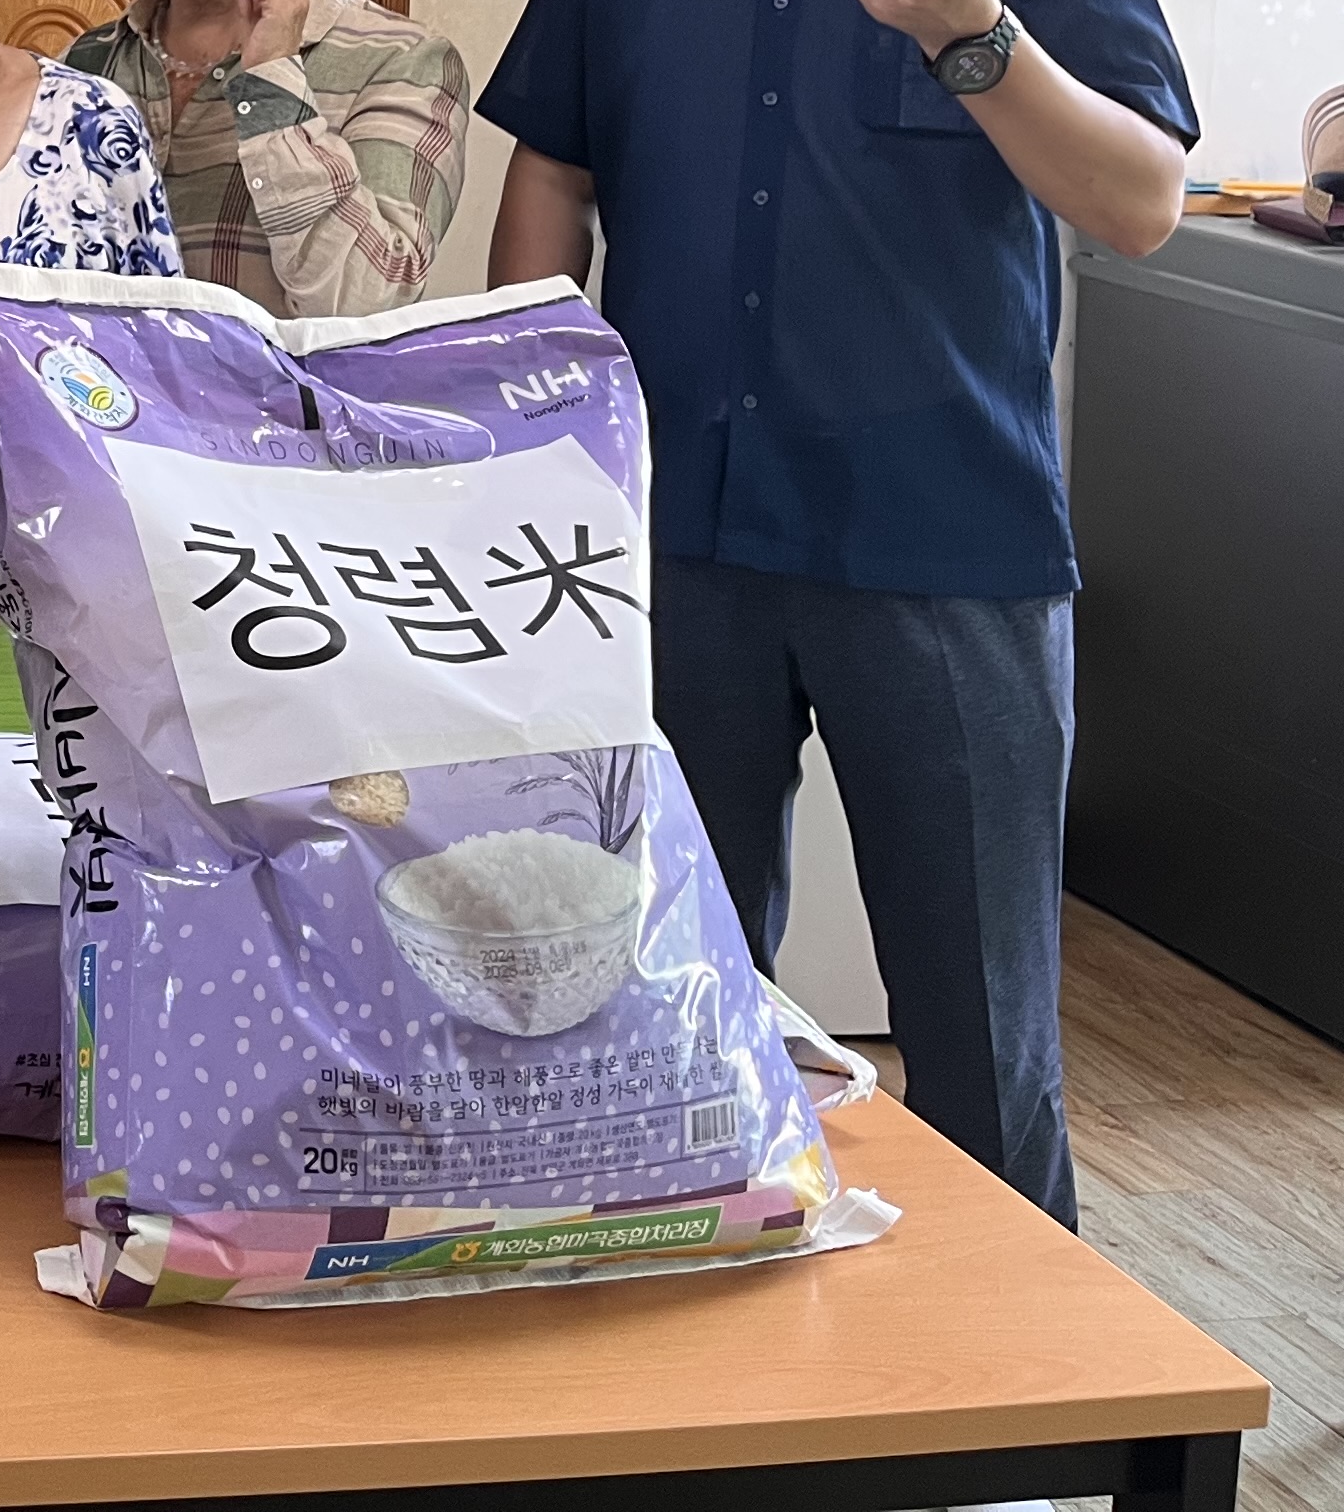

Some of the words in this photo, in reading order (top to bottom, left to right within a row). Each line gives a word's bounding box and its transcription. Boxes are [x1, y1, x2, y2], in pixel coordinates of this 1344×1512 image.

[498, 361, 590, 410] NH
[200, 432, 447, 465] SINDONGJIN
[321, 1067, 402, 1094] 미네랄이
[408, 1071, 462, 1097] 풍부한
[468, 1068, 506, 1090] 땅과
[513, 1060, 583, 1088] 해풍으로
[589, 1055, 620, 1078] 좋은
[626, 1048, 656, 1072] 쌀만
[317, 1094, 377, 1119] 햇빛의
[385, 1100, 443, 1123] 바람을
[450, 1095, 486, 1119] 담아
[492, 1090, 563, 1117] 한알한알
[569, 1086, 601, 1108] 정성
[607, 1077, 655, 1100] 가득이
[303, 1147, 338, 1174] 20
[340, 1159, 358, 1176] kg
[328, 1254, 370, 1268] NH
